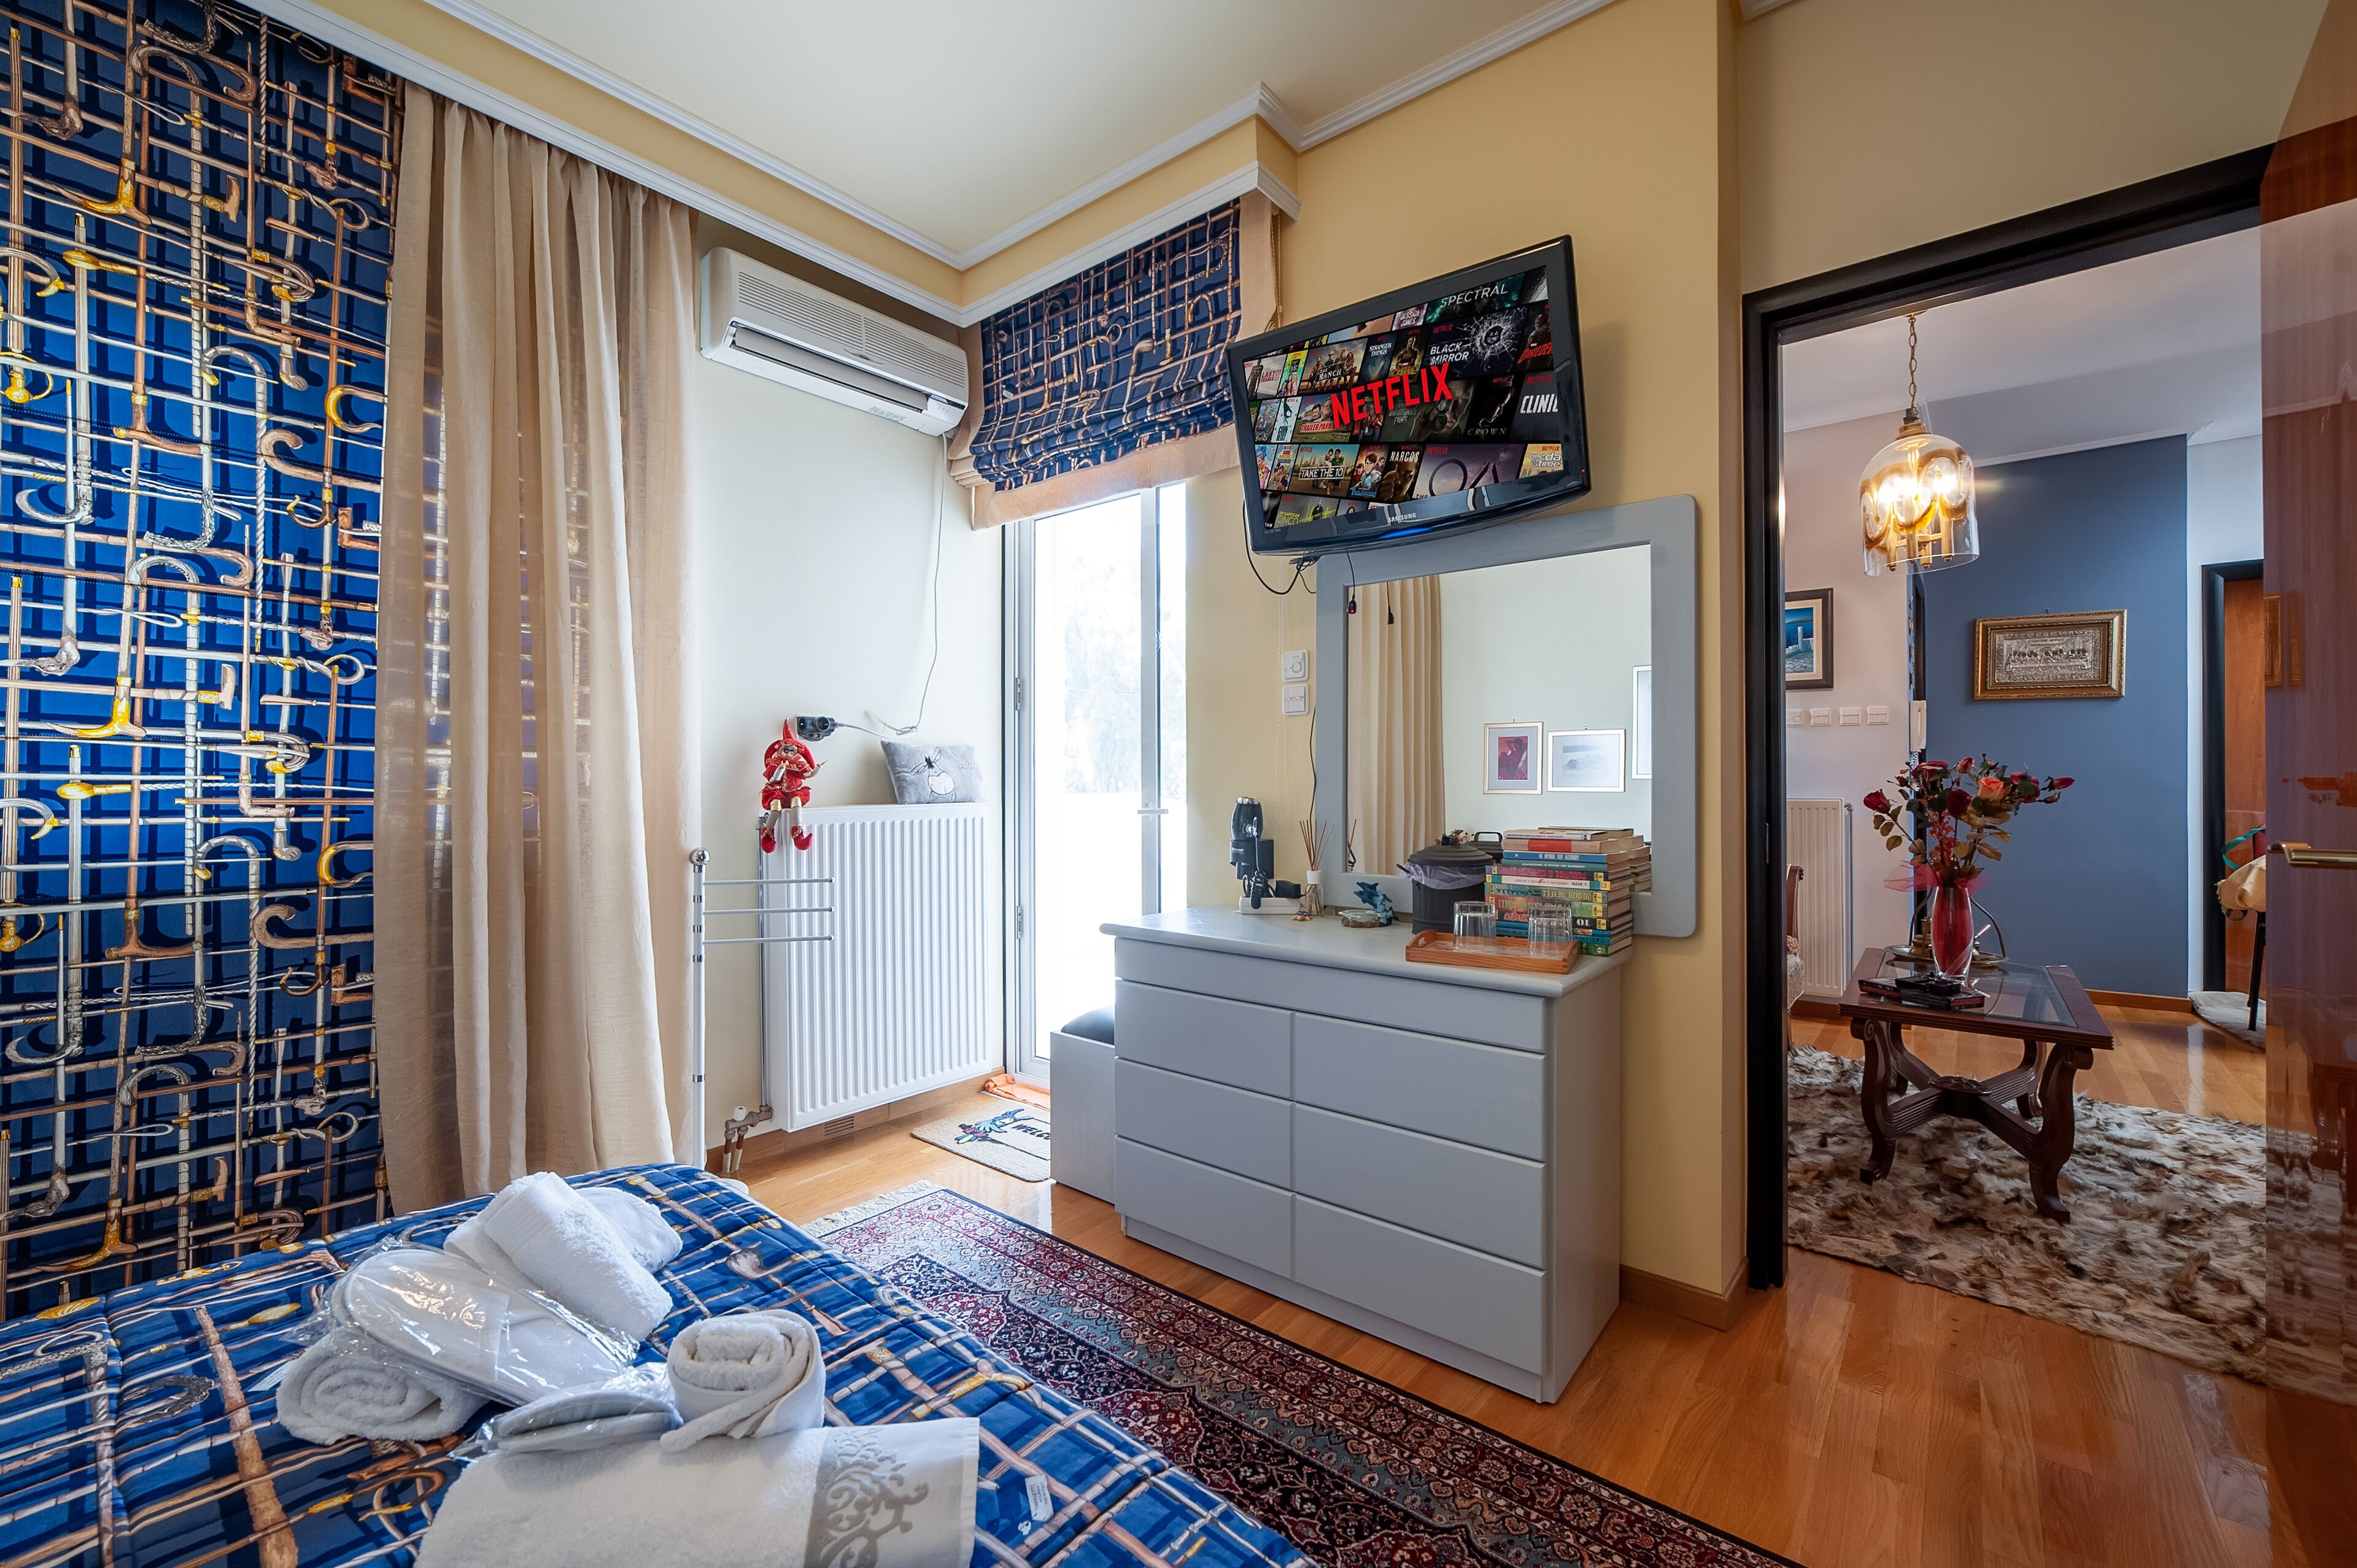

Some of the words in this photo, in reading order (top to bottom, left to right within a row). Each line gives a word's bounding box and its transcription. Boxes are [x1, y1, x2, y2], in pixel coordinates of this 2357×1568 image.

[1440, 284, 1508, 307] SPECTRAL
[1369, 342, 1392, 352] STRANGER
[1430, 341, 1462, 355] BLACK
[1430, 351, 1469, 366] MIRROR
[1319, 369, 1342, 380] RANCH
[1331, 362, 1453, 429] NETFLIX
[1301, 423, 1319, 432] TRAILER
[1390, 451, 1420, 462] NARCOS
[1301, 469, 1318, 478] TAKE
[1320, 468, 1334, 477] THE
[1335, 467, 1343, 477] 10
[1388, 512, 1417, 522] SAMSUNG
